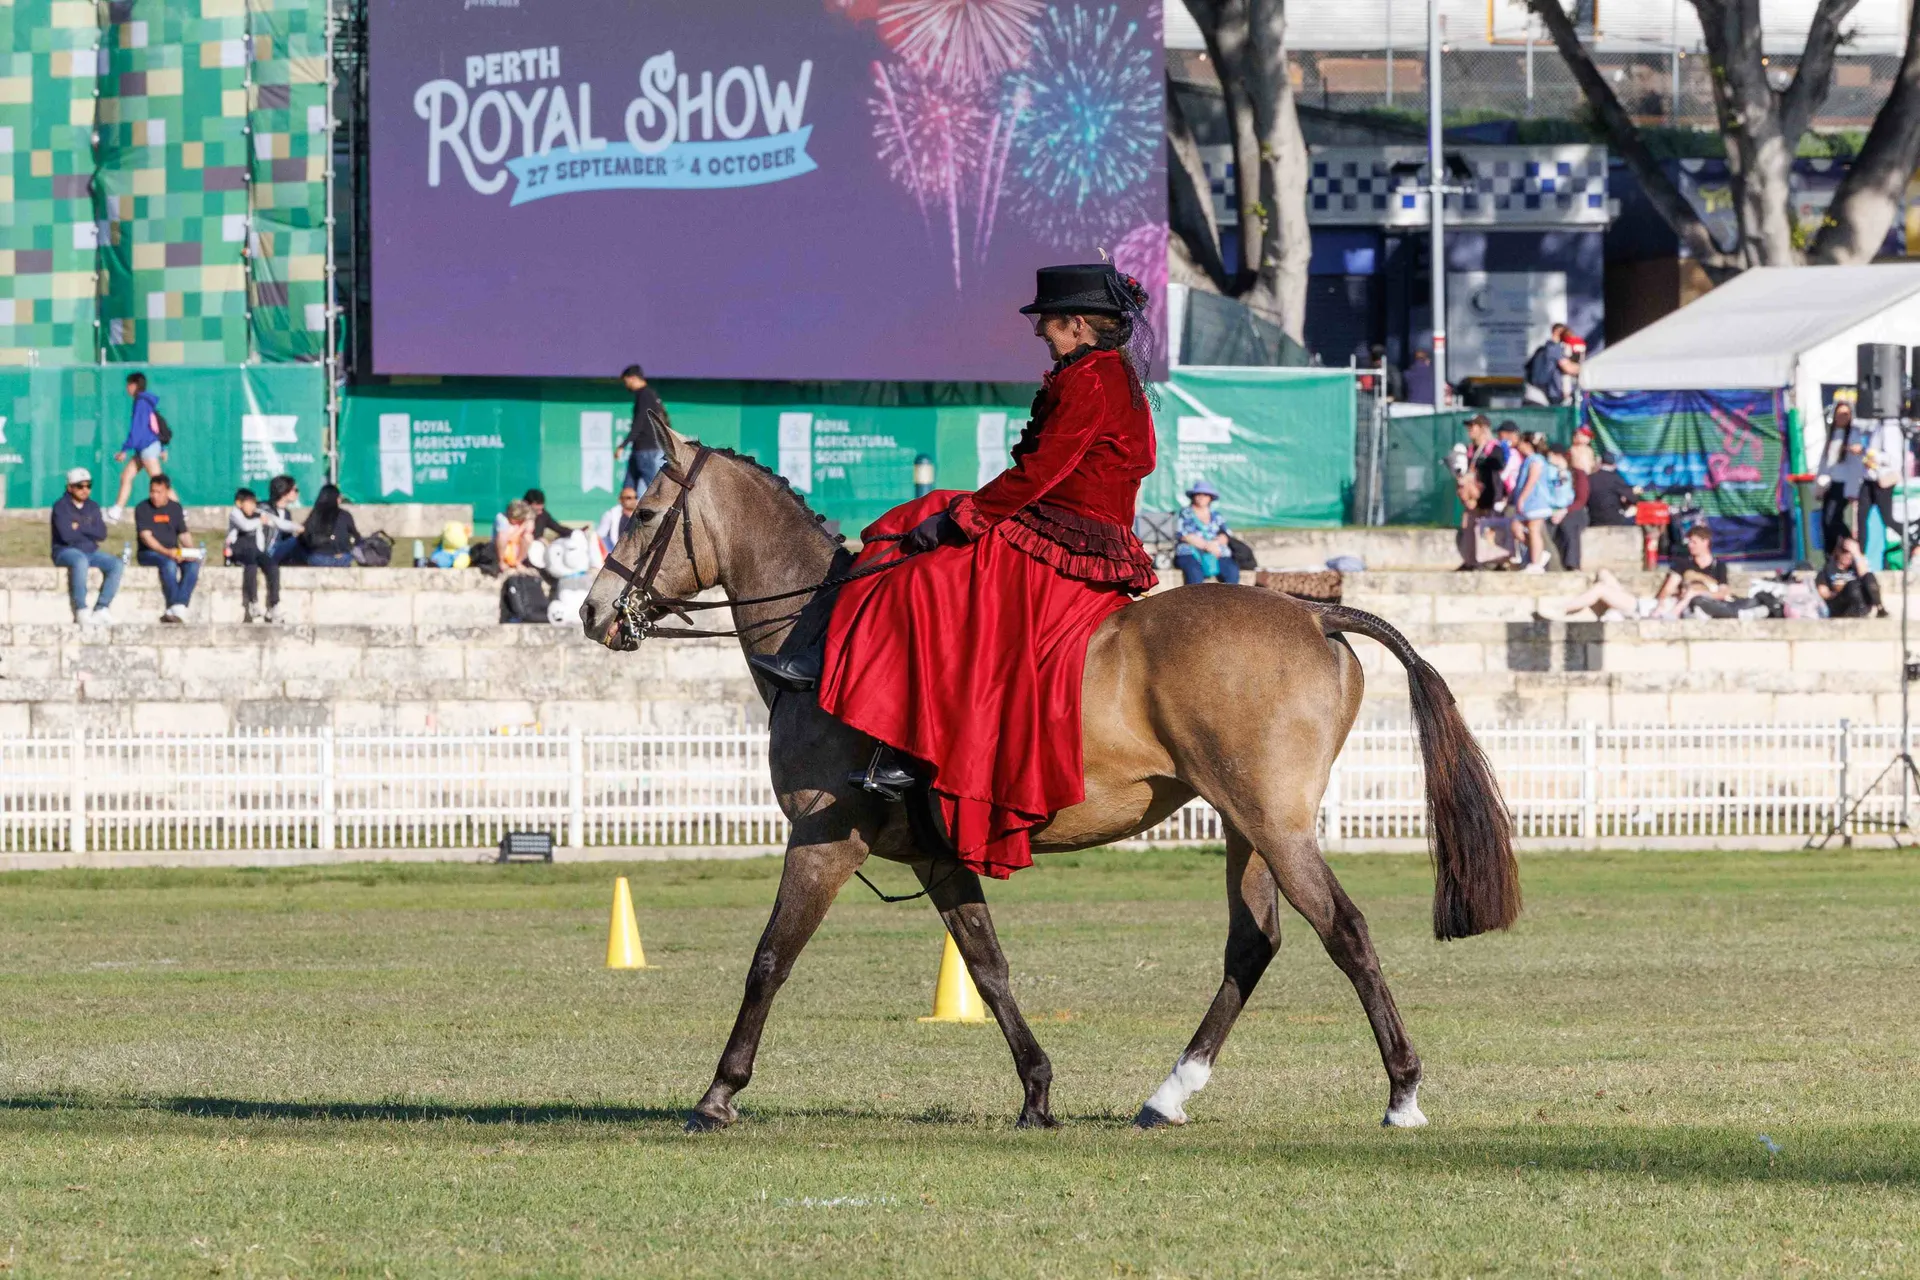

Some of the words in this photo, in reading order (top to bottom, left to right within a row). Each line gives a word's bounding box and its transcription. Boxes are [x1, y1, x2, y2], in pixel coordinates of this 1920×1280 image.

[466, 46, 561, 88] PERTH
[414, 79, 607, 195] ROYAL
[624, 49, 813, 154] SHOW
[526, 165, 549, 188] 27
[556, 156, 668, 181] SEPTEMBER
[690, 157, 702, 176] 4
[707, 147, 796, 176] OCTOBER
[413, 420, 452, 433] ROYAL
[414, 435, 505, 449] AGRICULTURAL
[414, 451, 467, 465] SOCIETY
